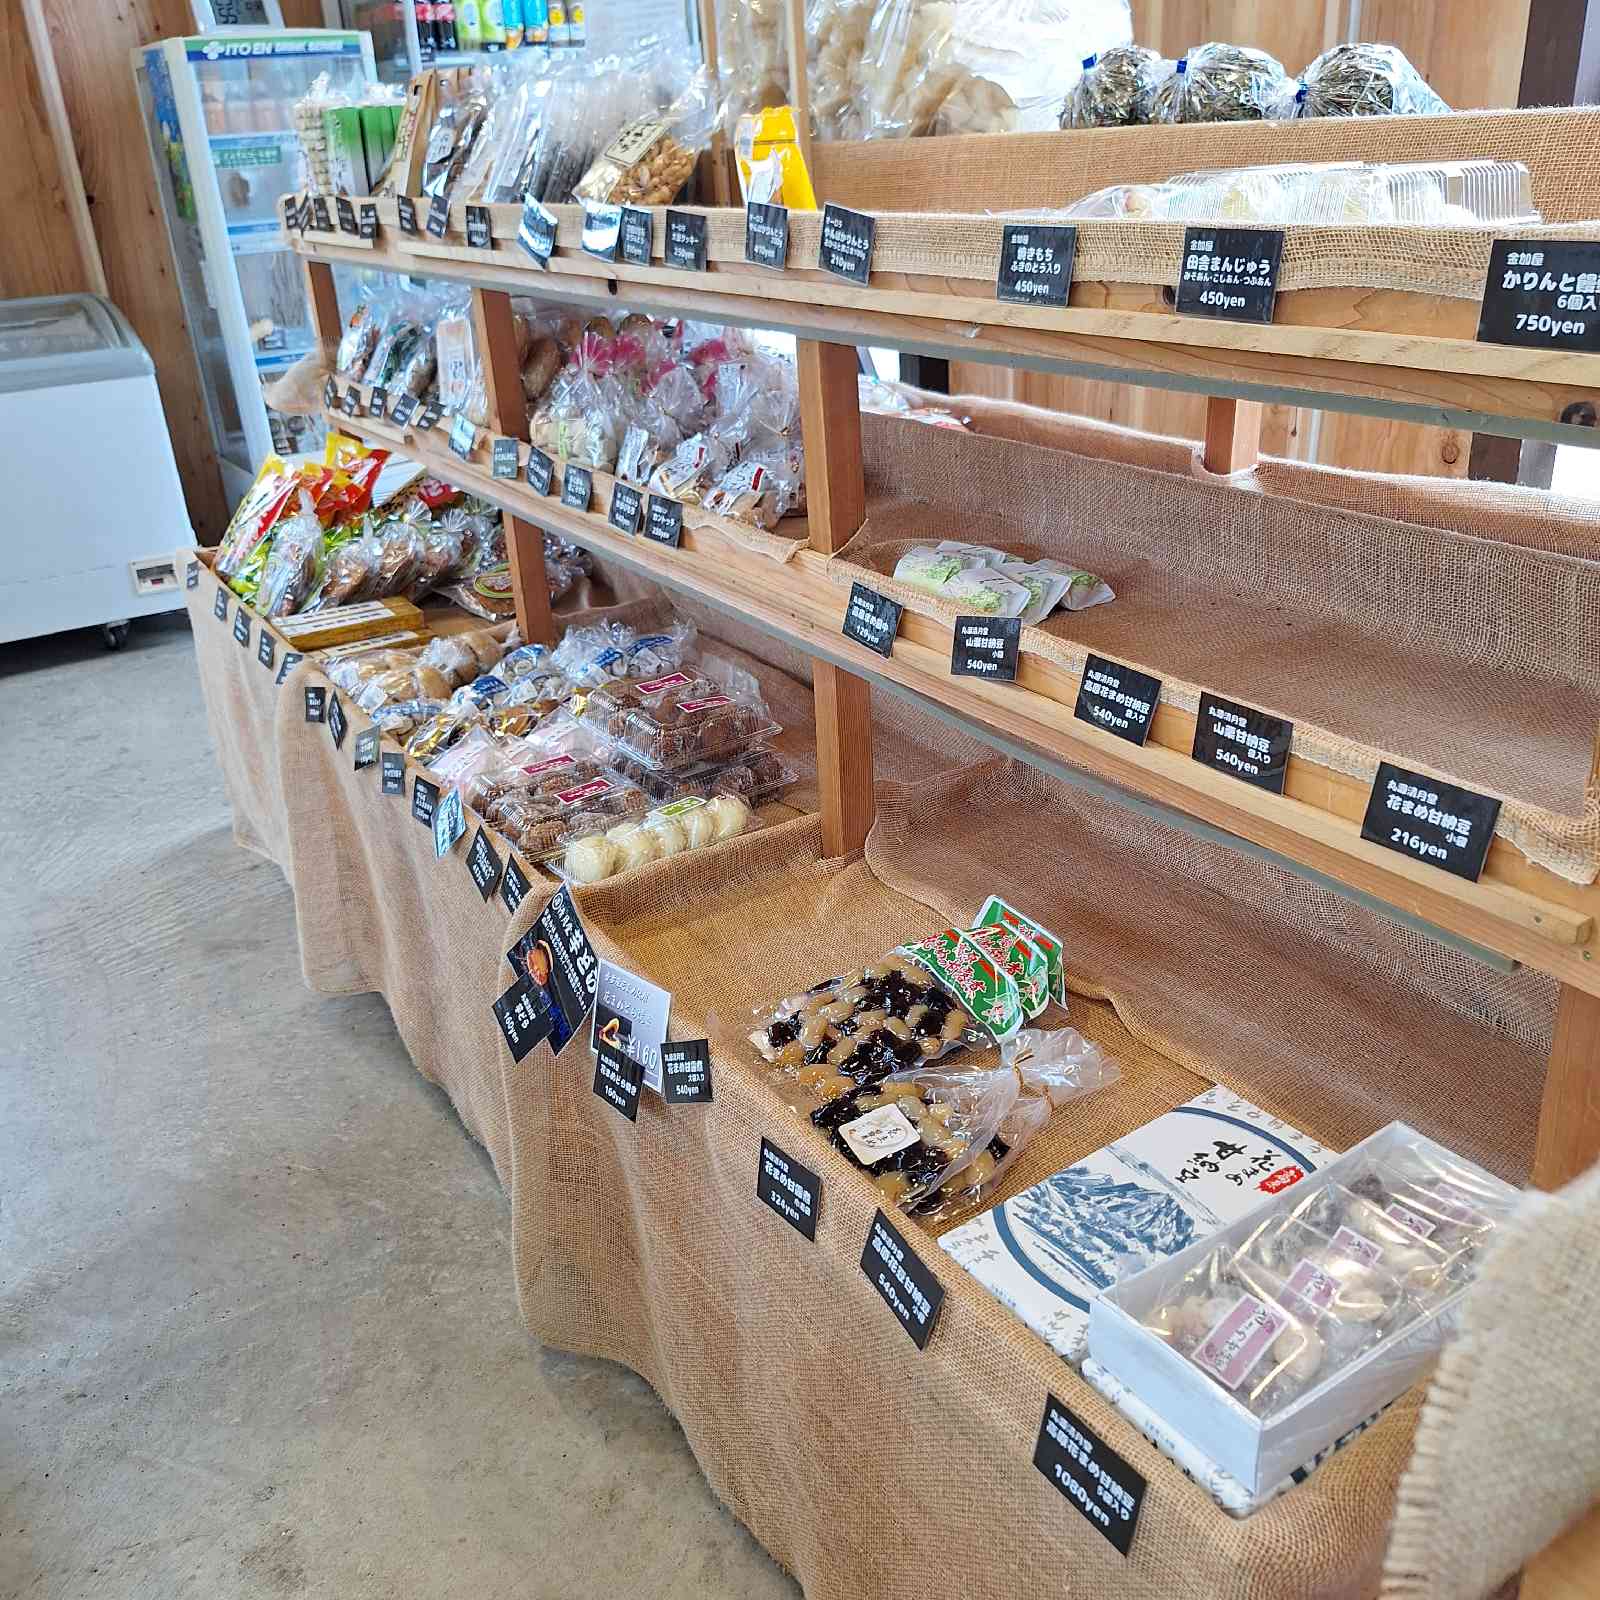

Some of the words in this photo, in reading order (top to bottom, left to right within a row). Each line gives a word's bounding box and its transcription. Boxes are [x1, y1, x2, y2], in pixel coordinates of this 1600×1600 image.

[224, 43, 250, 56] ITO
[252, 43, 273, 55] EN
[1017, 246, 1054, 262] 焼きもち
[1507, 252, 1545, 266] 金加屋
[1186, 255, 1270, 275] 田舎まんじゅう
[1015, 280, 1049, 296] 450yen
[1200, 291, 1245, 309] 450yen
[1557, 294, 1600, 310] 6個入
[1516, 314, 1585, 337] 750yen
[967, 659, 997, 672] 540yen
[1093, 705, 1128, 729] 540yen
[1215, 748, 1258, 775] 540yen
[1386, 793, 1473, 836] 花まめ甘納豆
[1390, 827, 1448, 860] 216yen
[770, 1190, 799, 1221] 324yen
[878, 1272, 910, 1321] 540yen
[1055, 1463, 1110, 1527] 1080yen
